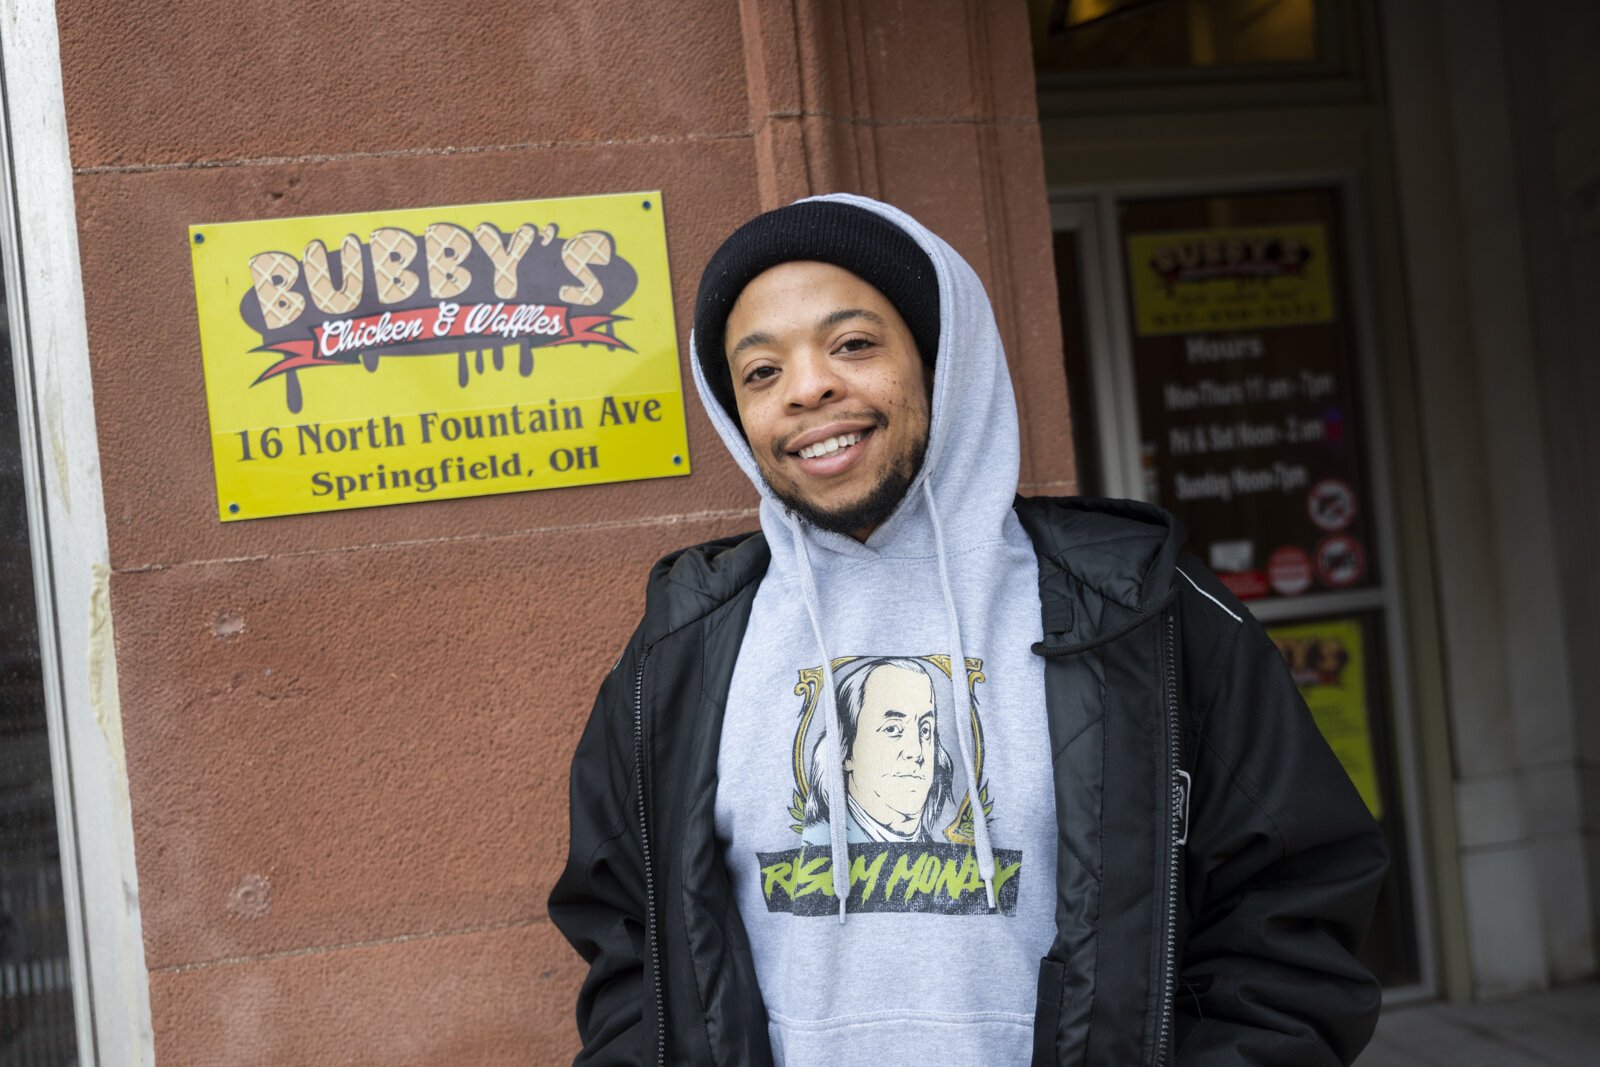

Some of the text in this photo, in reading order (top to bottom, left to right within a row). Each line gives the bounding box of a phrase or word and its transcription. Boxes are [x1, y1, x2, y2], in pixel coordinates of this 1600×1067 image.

[248, 222, 613, 330] BUBBY'S
[319, 302, 565, 357] Chicken & Waffles
[1186, 337, 1263, 363] Hours
[234, 396, 663, 462] 16 North Fountain Ave
[311, 446, 600, 501] Springfield, OH
